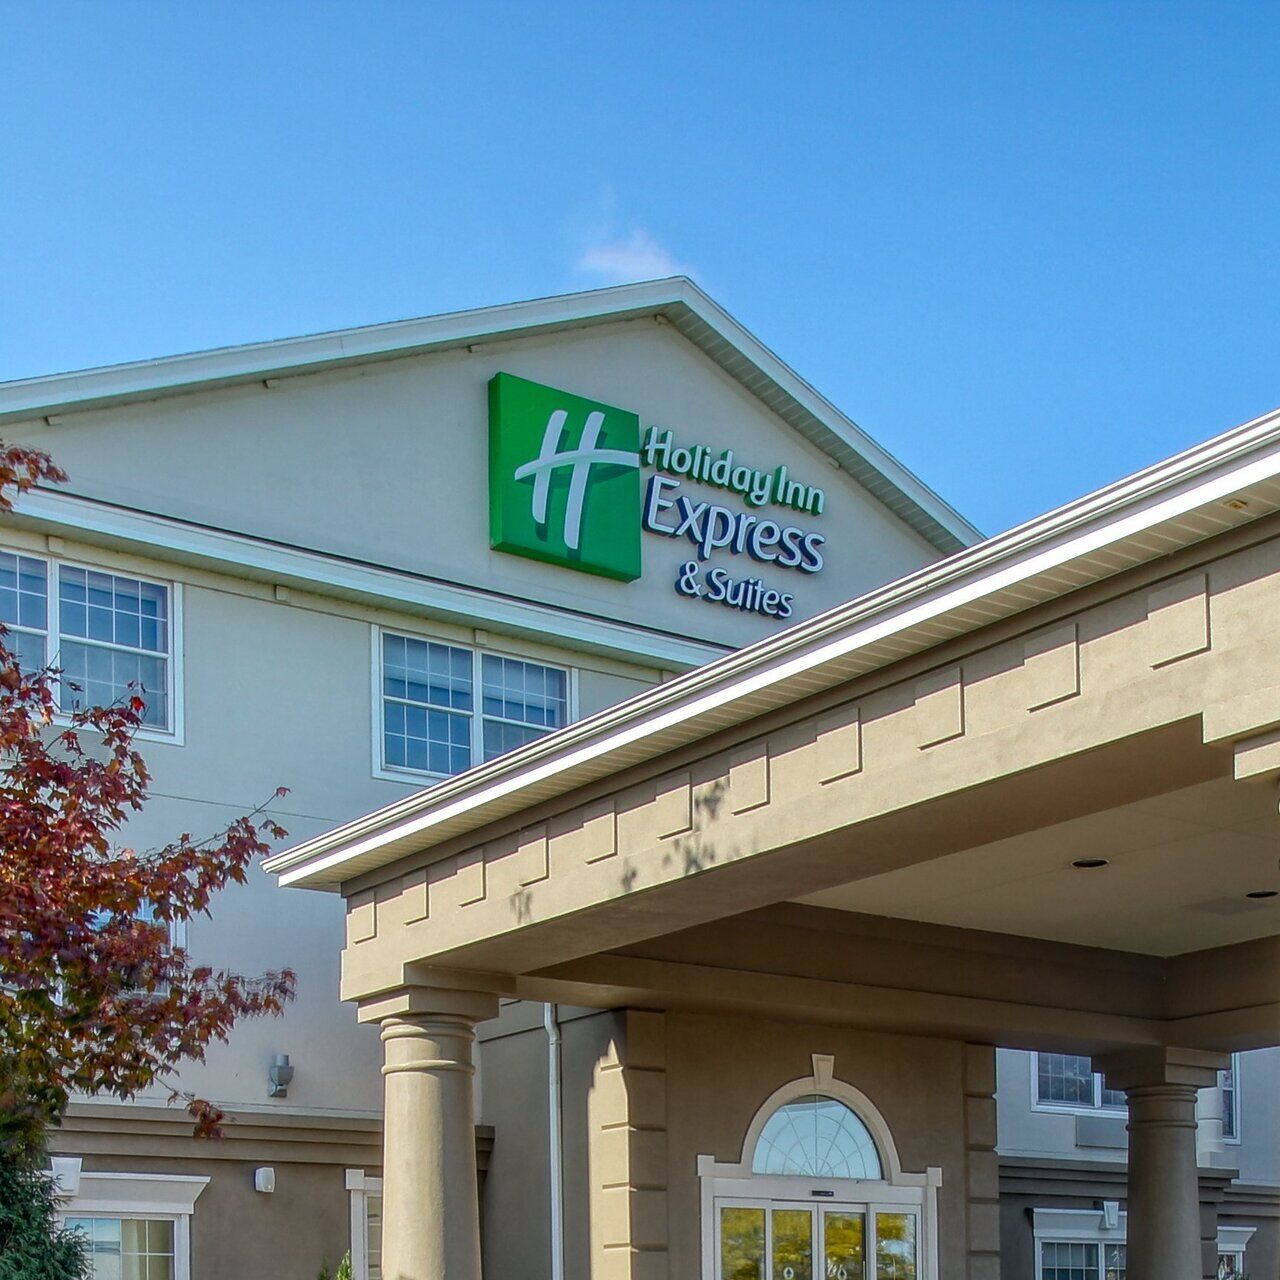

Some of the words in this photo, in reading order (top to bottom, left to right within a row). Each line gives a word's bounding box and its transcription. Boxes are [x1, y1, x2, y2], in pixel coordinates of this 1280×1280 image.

[642, 425, 772, 506] Holiday
[772, 465, 825, 516] Inn
[642, 474, 826, 574] Express
[675, 560, 701, 597] &
[706, 567, 794, 619] Suites
